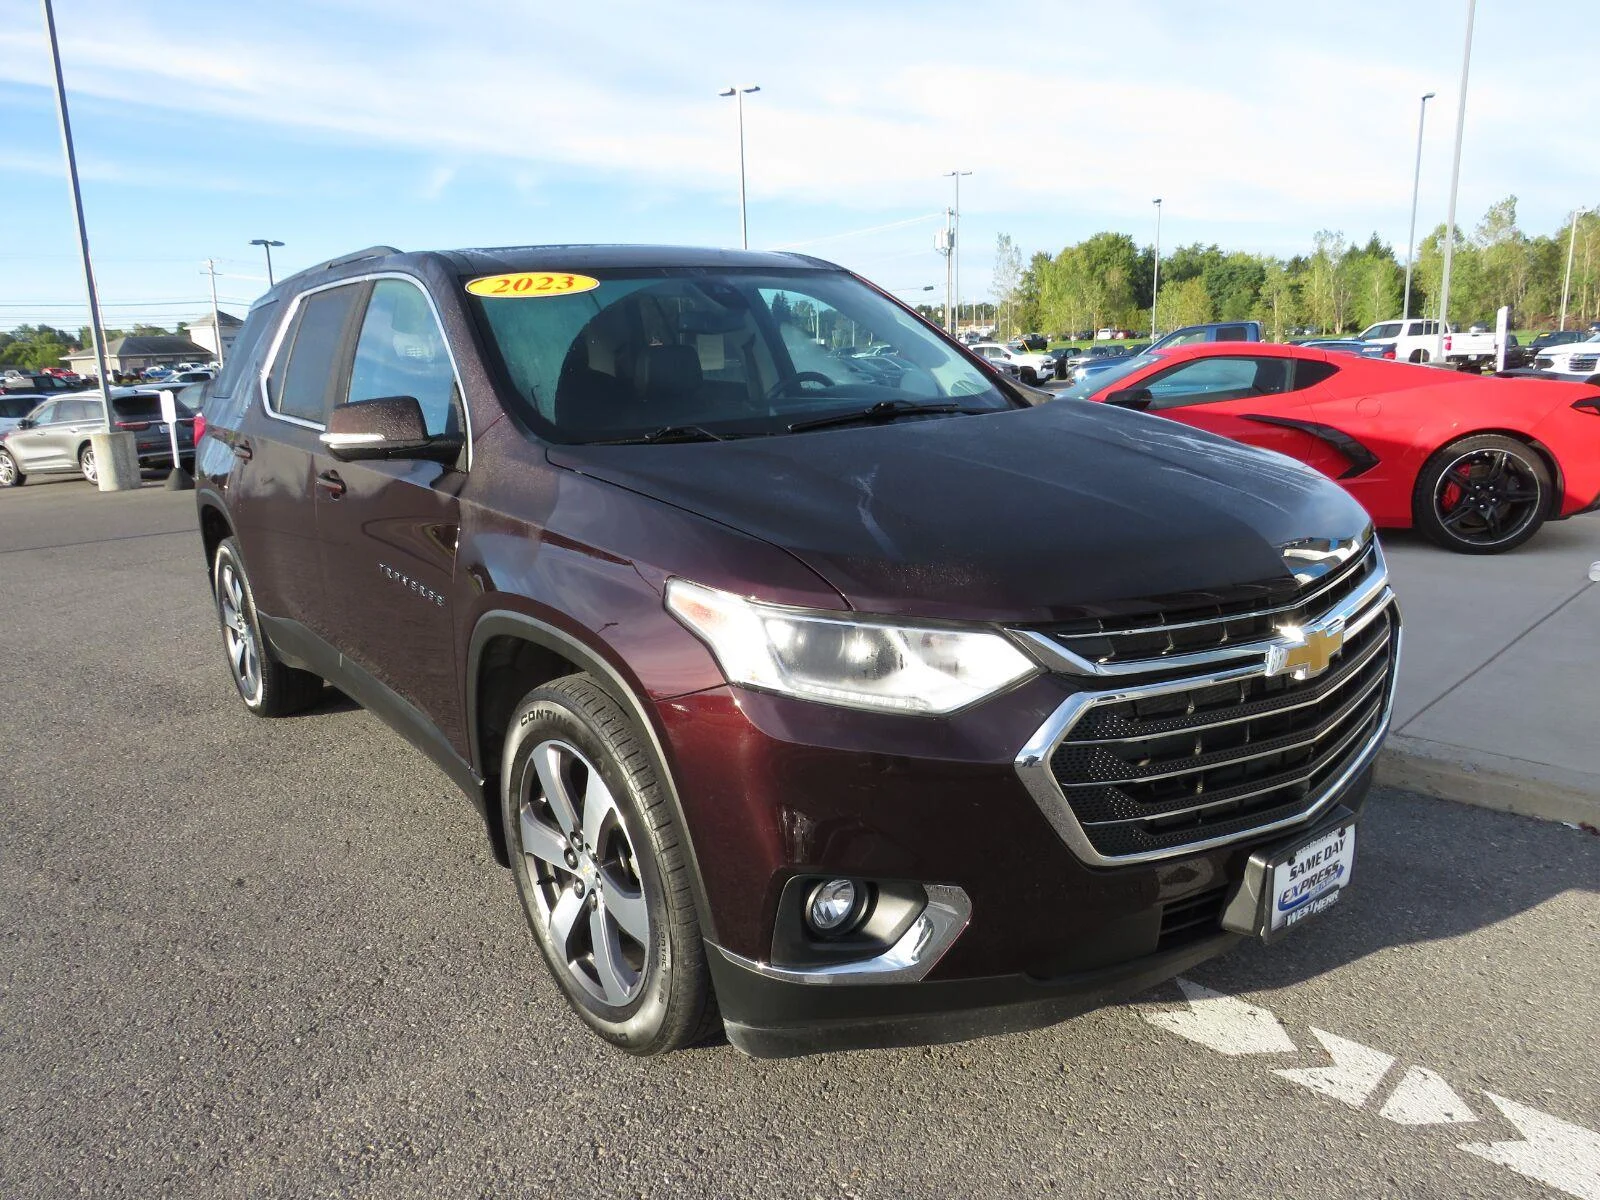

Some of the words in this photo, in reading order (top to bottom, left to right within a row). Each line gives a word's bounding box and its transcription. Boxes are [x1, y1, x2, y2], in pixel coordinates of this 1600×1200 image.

[492, 276, 575, 294] 2023
[1289, 850, 1323, 882] SAME
[1323, 837, 1347, 861] DAY
[1281, 860, 1342, 905] EXPRESS
